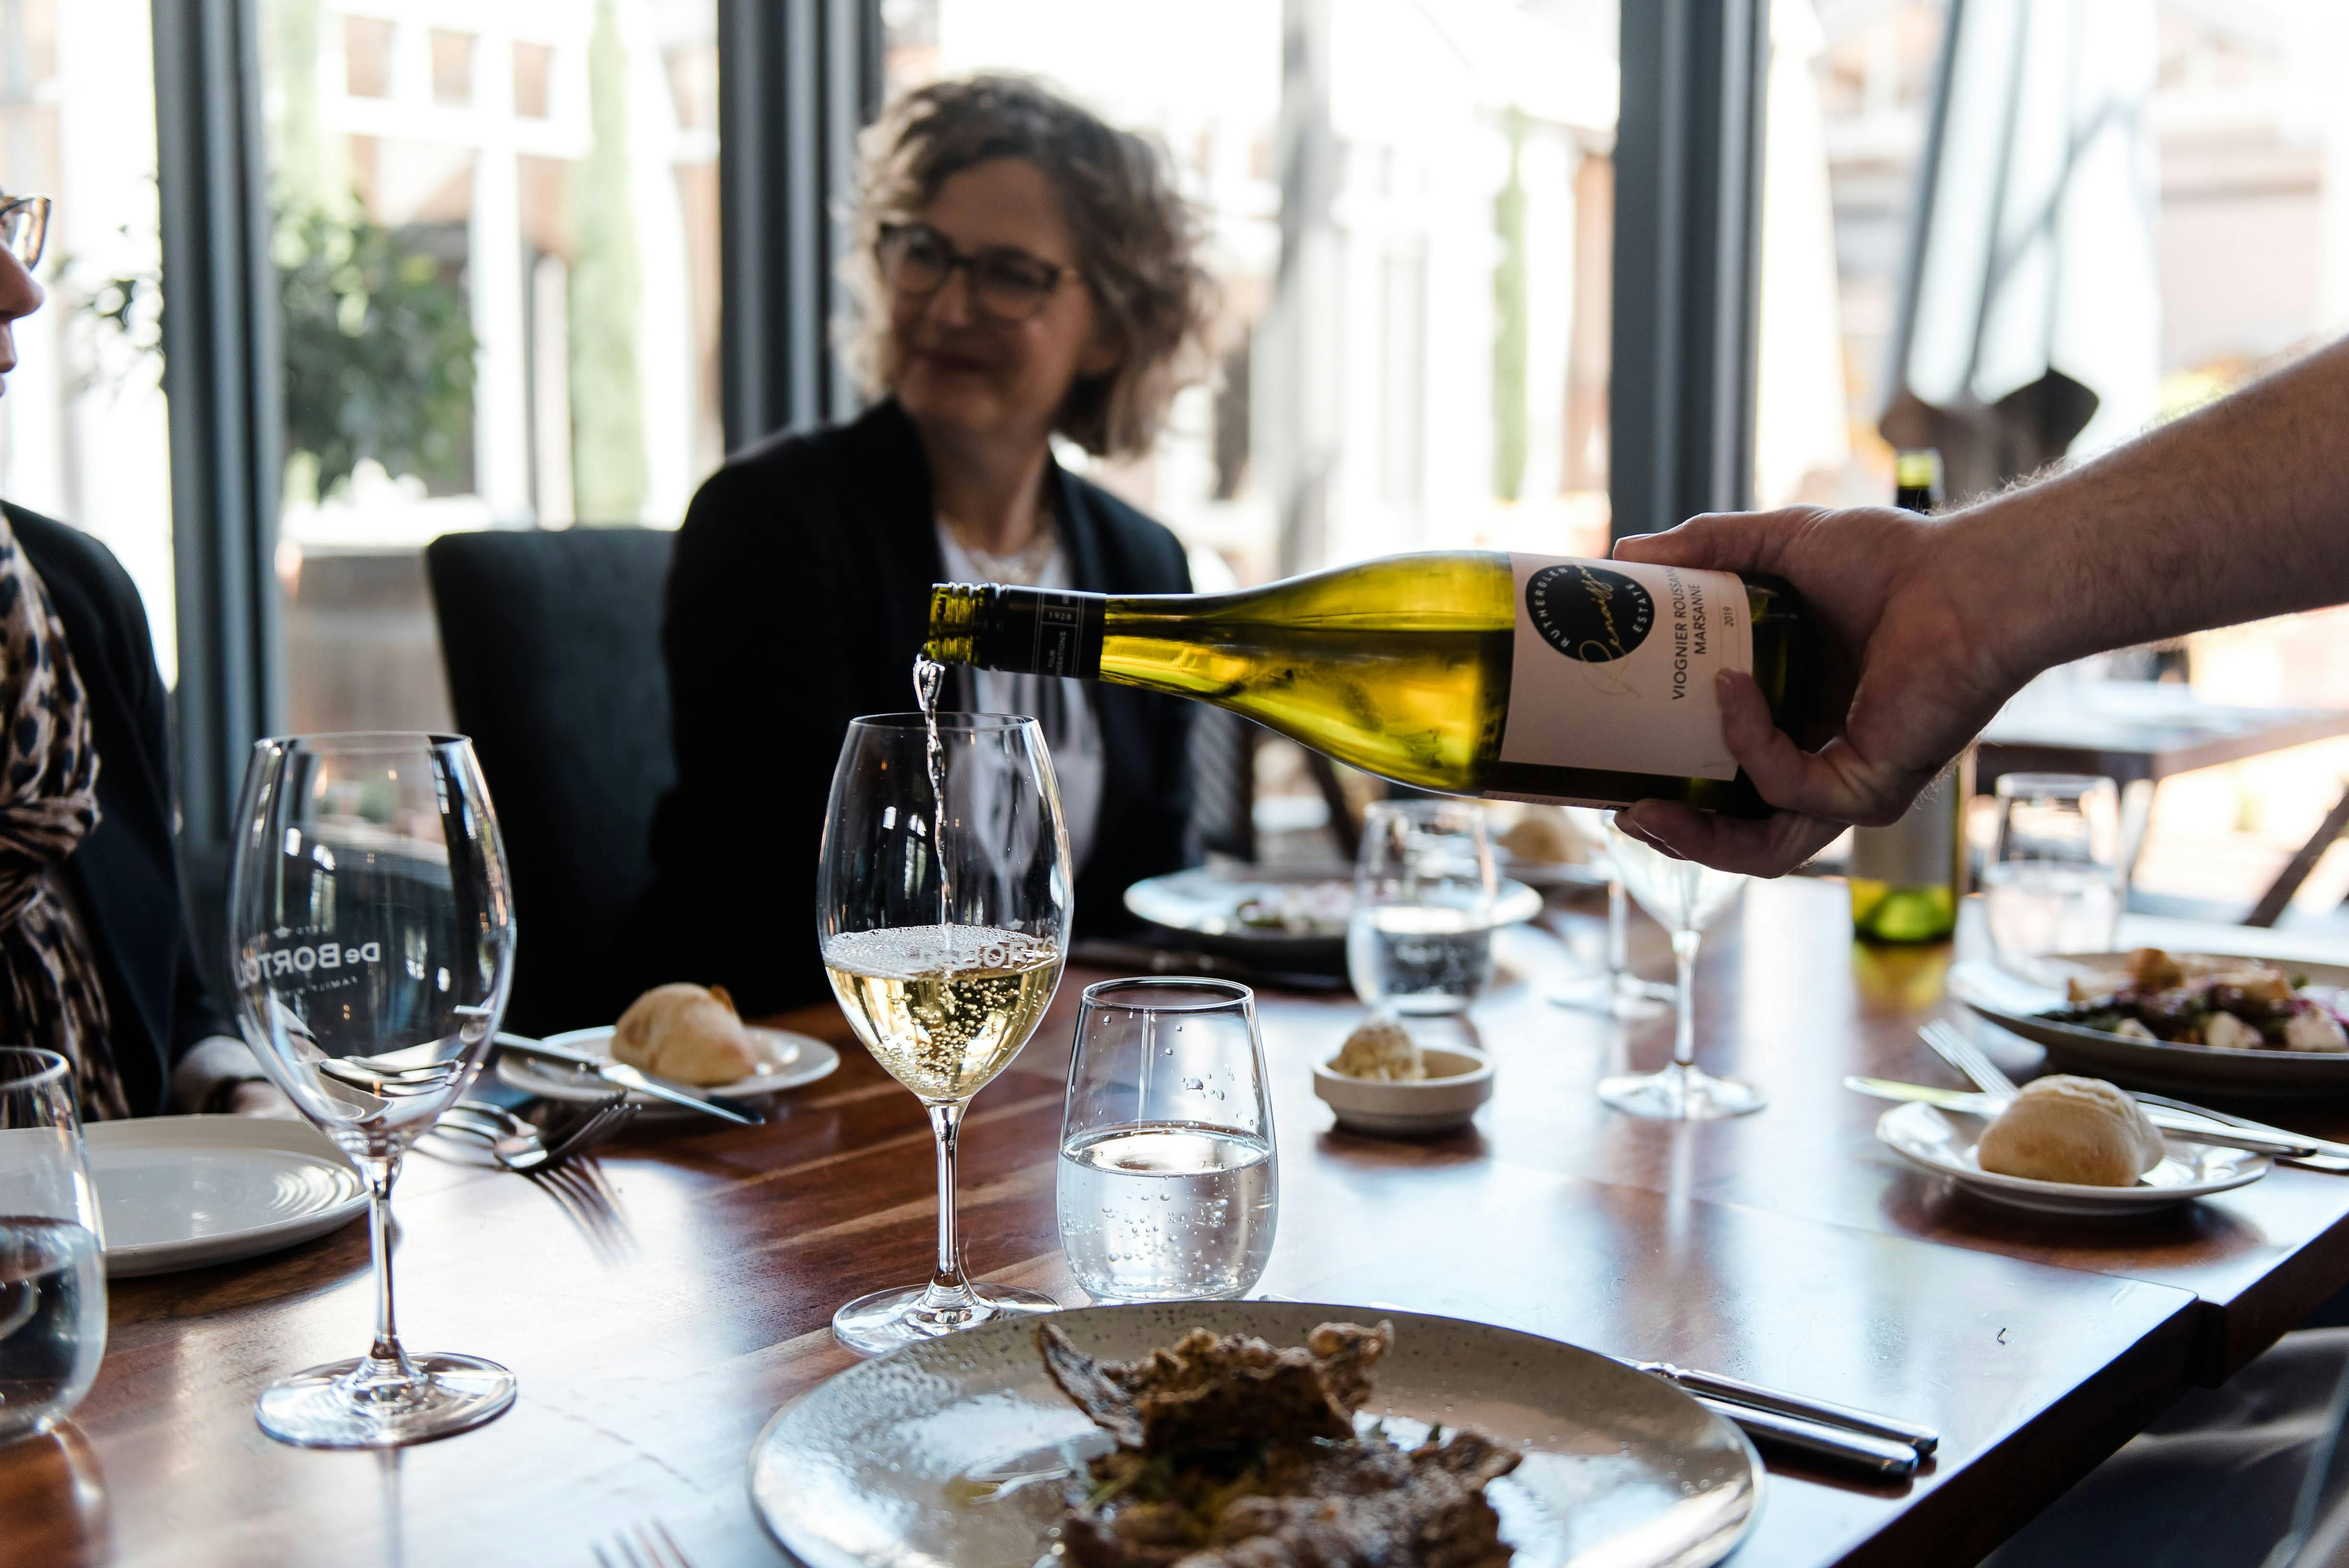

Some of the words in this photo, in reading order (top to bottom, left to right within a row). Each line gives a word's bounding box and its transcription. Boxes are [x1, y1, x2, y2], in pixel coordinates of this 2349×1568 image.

[1048, 611, 1072, 620] 1928
[1534, 567, 1569, 648] RUTHERGLEN
[1625, 582, 1649, 633] ESTATE
[1687, 583, 1707, 654] MARSANNE
[1723, 606, 1734, 628] 2019
[1672, 623, 1688, 701] VIOGNIER
